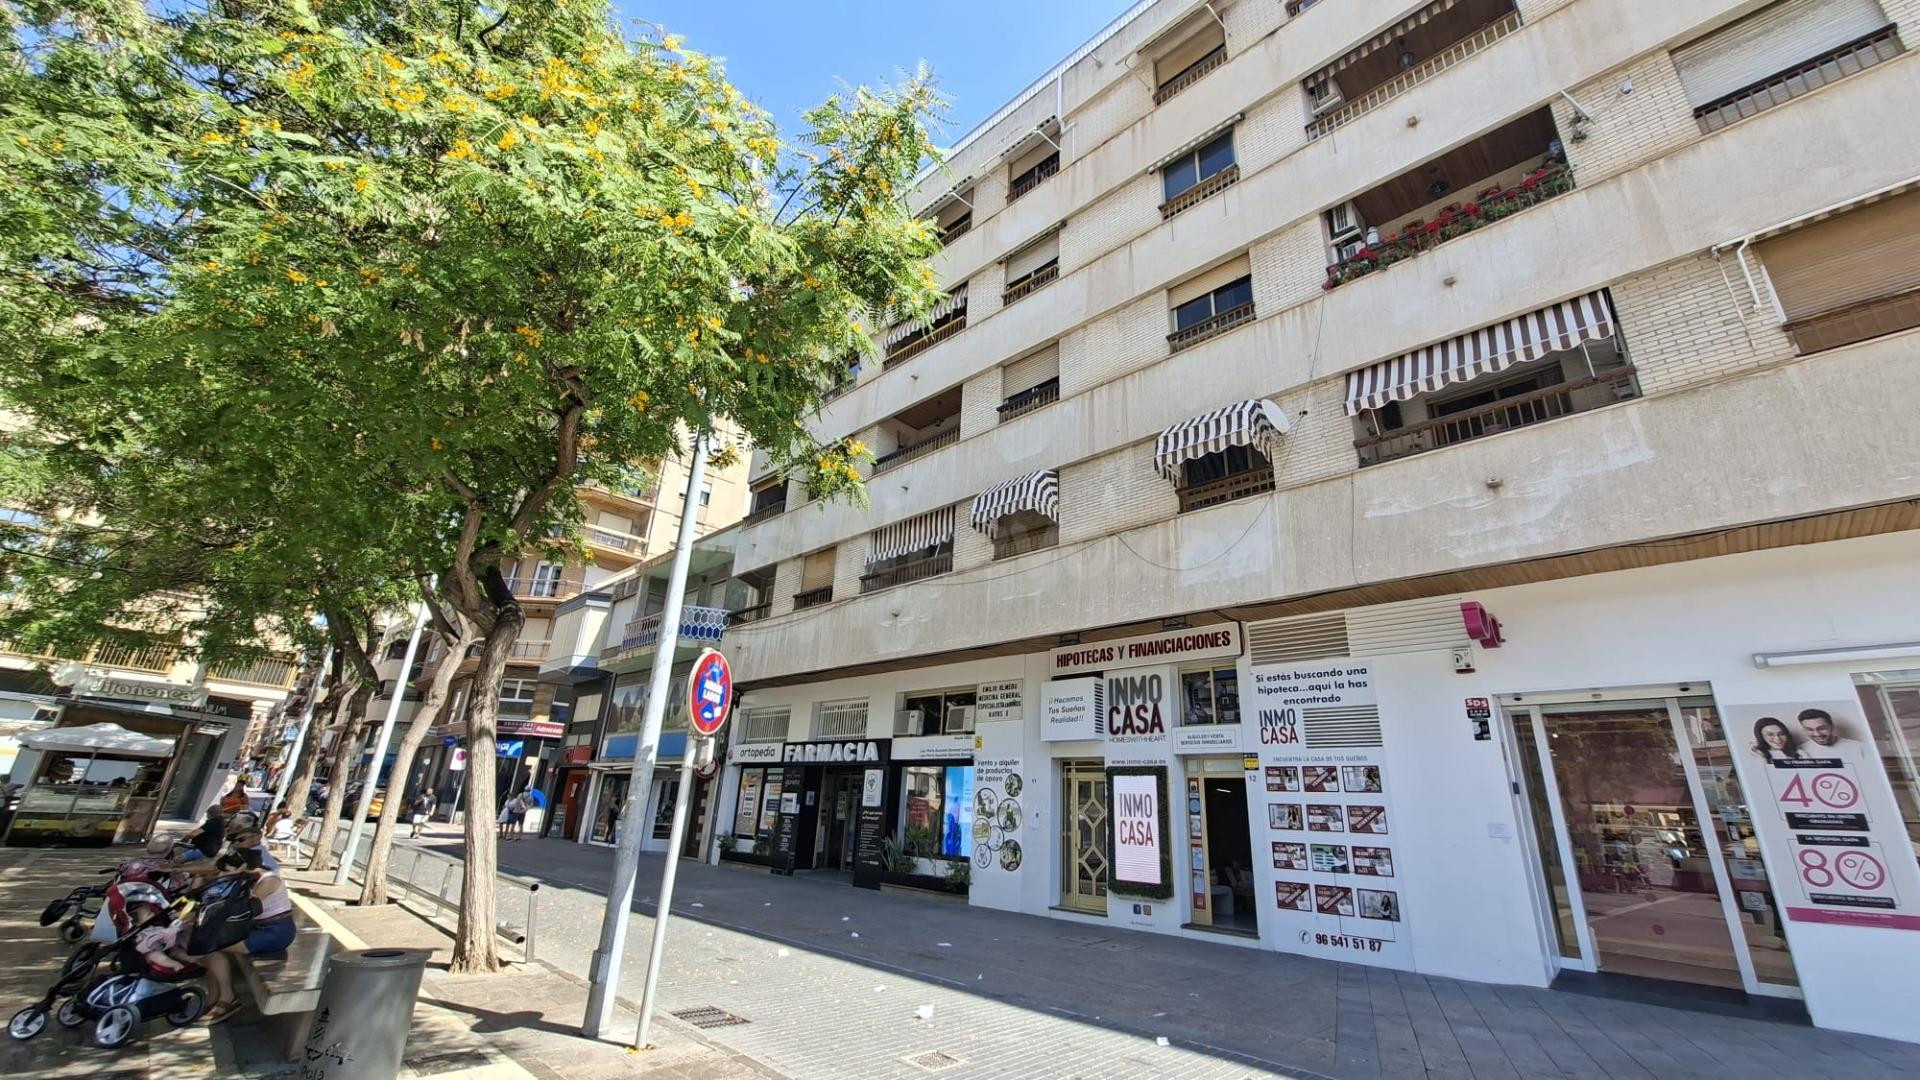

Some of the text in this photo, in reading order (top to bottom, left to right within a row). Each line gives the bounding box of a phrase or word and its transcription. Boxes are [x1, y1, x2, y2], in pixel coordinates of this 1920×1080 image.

[1056, 630, 1231, 668] HIPOTECAS Y FINANCIACIONES
[1255, 667, 1368, 683] Si estás buscando una
[1334, 681, 1345, 689] la
[1348, 680, 1368, 689] has
[1000, 692, 1021, 700] GENERAL
[1108, 674, 1162, 706] INMO
[1283, 694, 1341, 705] encontrado
[1061, 705, 1086, 713] Sueños
[1466, 699, 1488, 708] SDS
[1108, 703, 1165, 735] CASA
[1258, 708, 1296, 727] INMO
[1260, 726, 1299, 745] CASA
[739, 745, 776, 759] ortopedia
[783, 742, 879, 762] FARMACIA
[999, 759, 1020, 767] alquiler
[1119, 793, 1153, 818] INMO
[1120, 819, 1154, 847] CASA
[1315, 933, 1382, 953] 96 541 51 87
